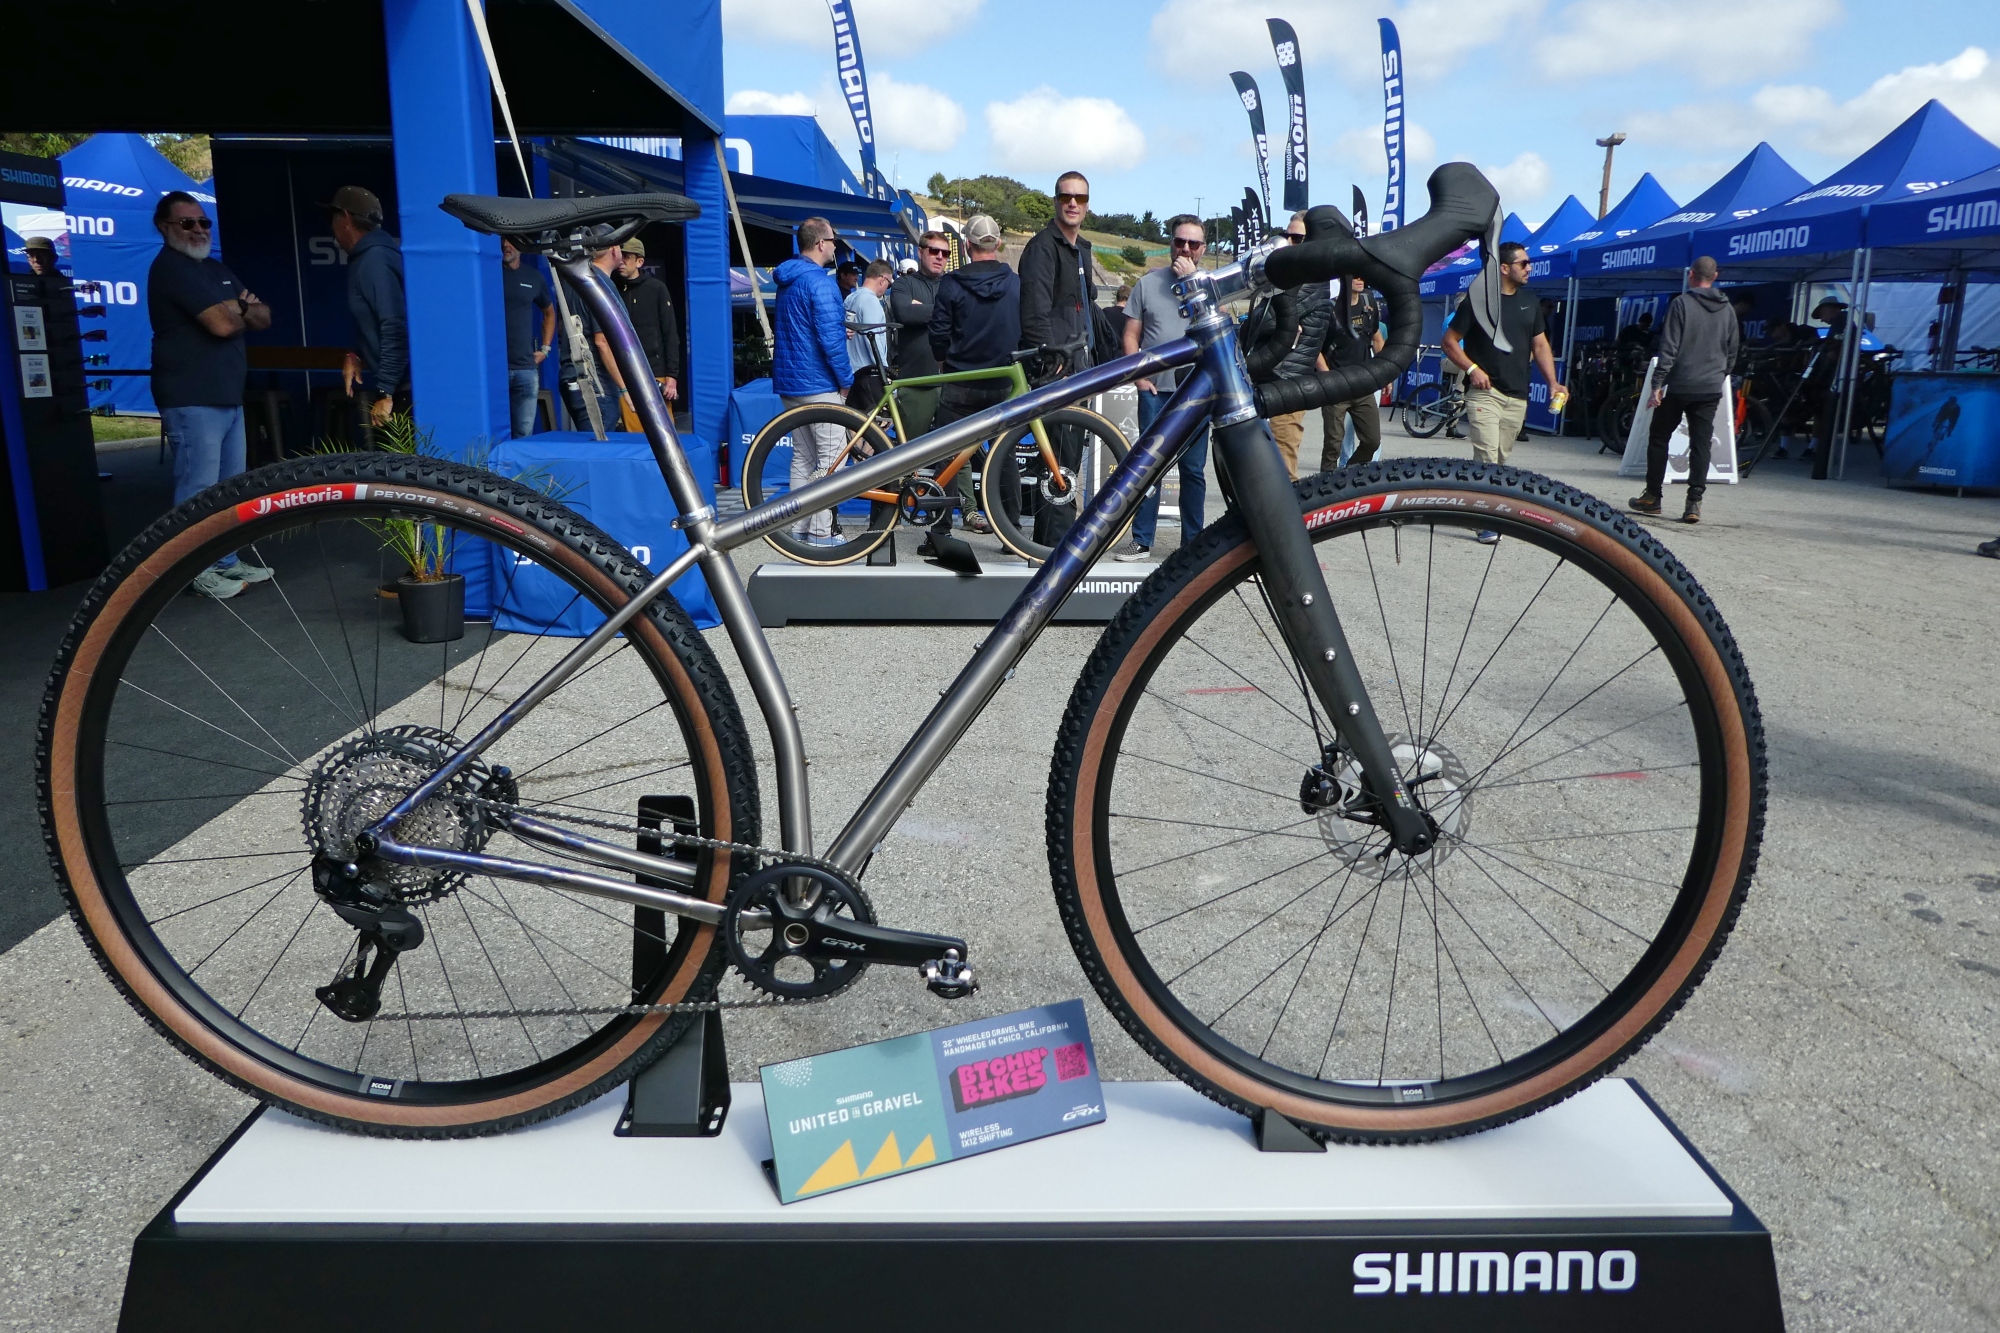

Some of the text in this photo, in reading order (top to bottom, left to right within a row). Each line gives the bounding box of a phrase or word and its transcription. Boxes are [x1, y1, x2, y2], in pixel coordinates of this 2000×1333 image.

[830, 0, 872, 143] HIMANO
[1, 168, 57, 188] SHIMANO
[63, 177, 143, 197] MANO
[1926, 200, 2000, 233] SHIM
[1728, 225, 1810, 256] SHIMANO
[1601, 245, 1656, 270] SHIMANO
[1919, 465, 1956, 477] SHIMANO
[273, 486, 437, 509] vittoria PEYOTE
[1401, 496, 1467, 506] MEZCAL
[742, 497, 801, 535] BANDITO
[1390, 768, 1413, 809] RITCHEY
[821, 937, 867, 951] GRX
[943, 1021, 1069, 1057] HANDMADE IN CHICO, CALIFORNIA
[956, 1032, 991, 1045] WHEELED
[991, 1025, 1018, 1037] GRAVEL
[1018, 1020, 1035, 1031] BIKE
[371, 1082, 392, 1090] KOM
[960, 1062, 1048, 1105] BIKES
[1402, 1088, 1423, 1096] KOM
[836, 1090, 874, 1105] SHIMANO
[789, 1091, 923, 1135] UNITED IN GRAVEL
[1062, 1104, 1100, 1121] GRX
[959, 1122, 1000, 1139] WIRELESS
[961, 1127, 1014, 1148] 1X12 SHIFTING
[1352, 1249, 1637, 1294] SHIMANO
